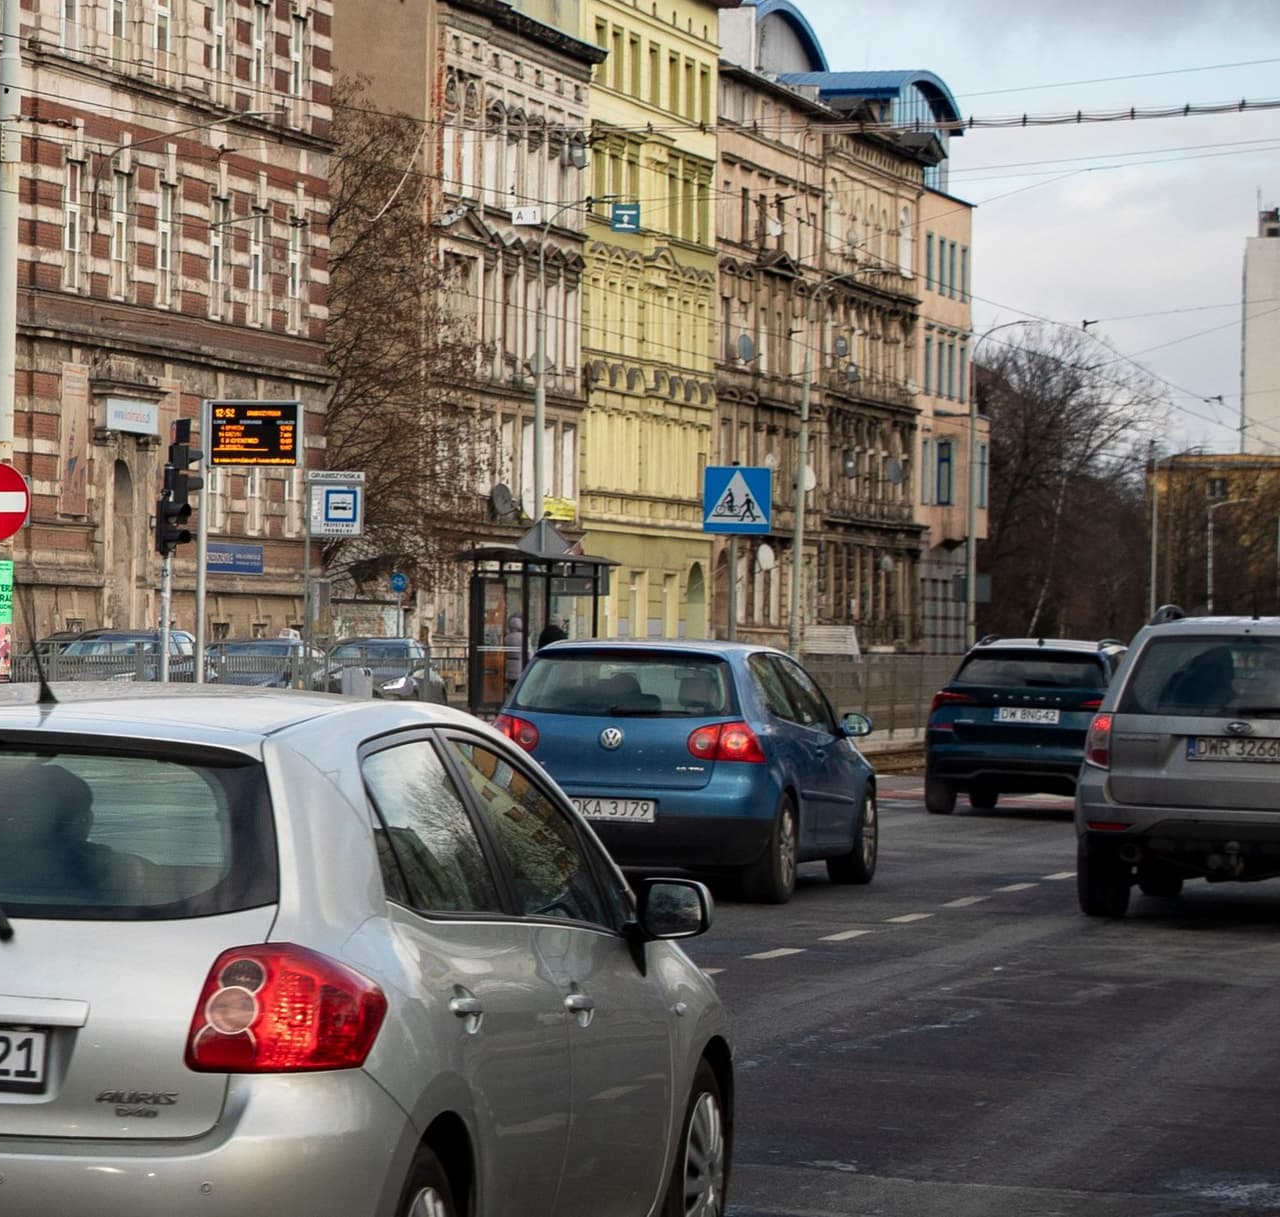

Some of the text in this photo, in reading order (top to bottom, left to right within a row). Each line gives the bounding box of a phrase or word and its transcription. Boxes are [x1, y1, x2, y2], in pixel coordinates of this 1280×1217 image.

[1001, 707, 1017, 719] DW
[1197, 739, 1280, 757] DWR 3266
[609, 800, 651, 817] 3J79
